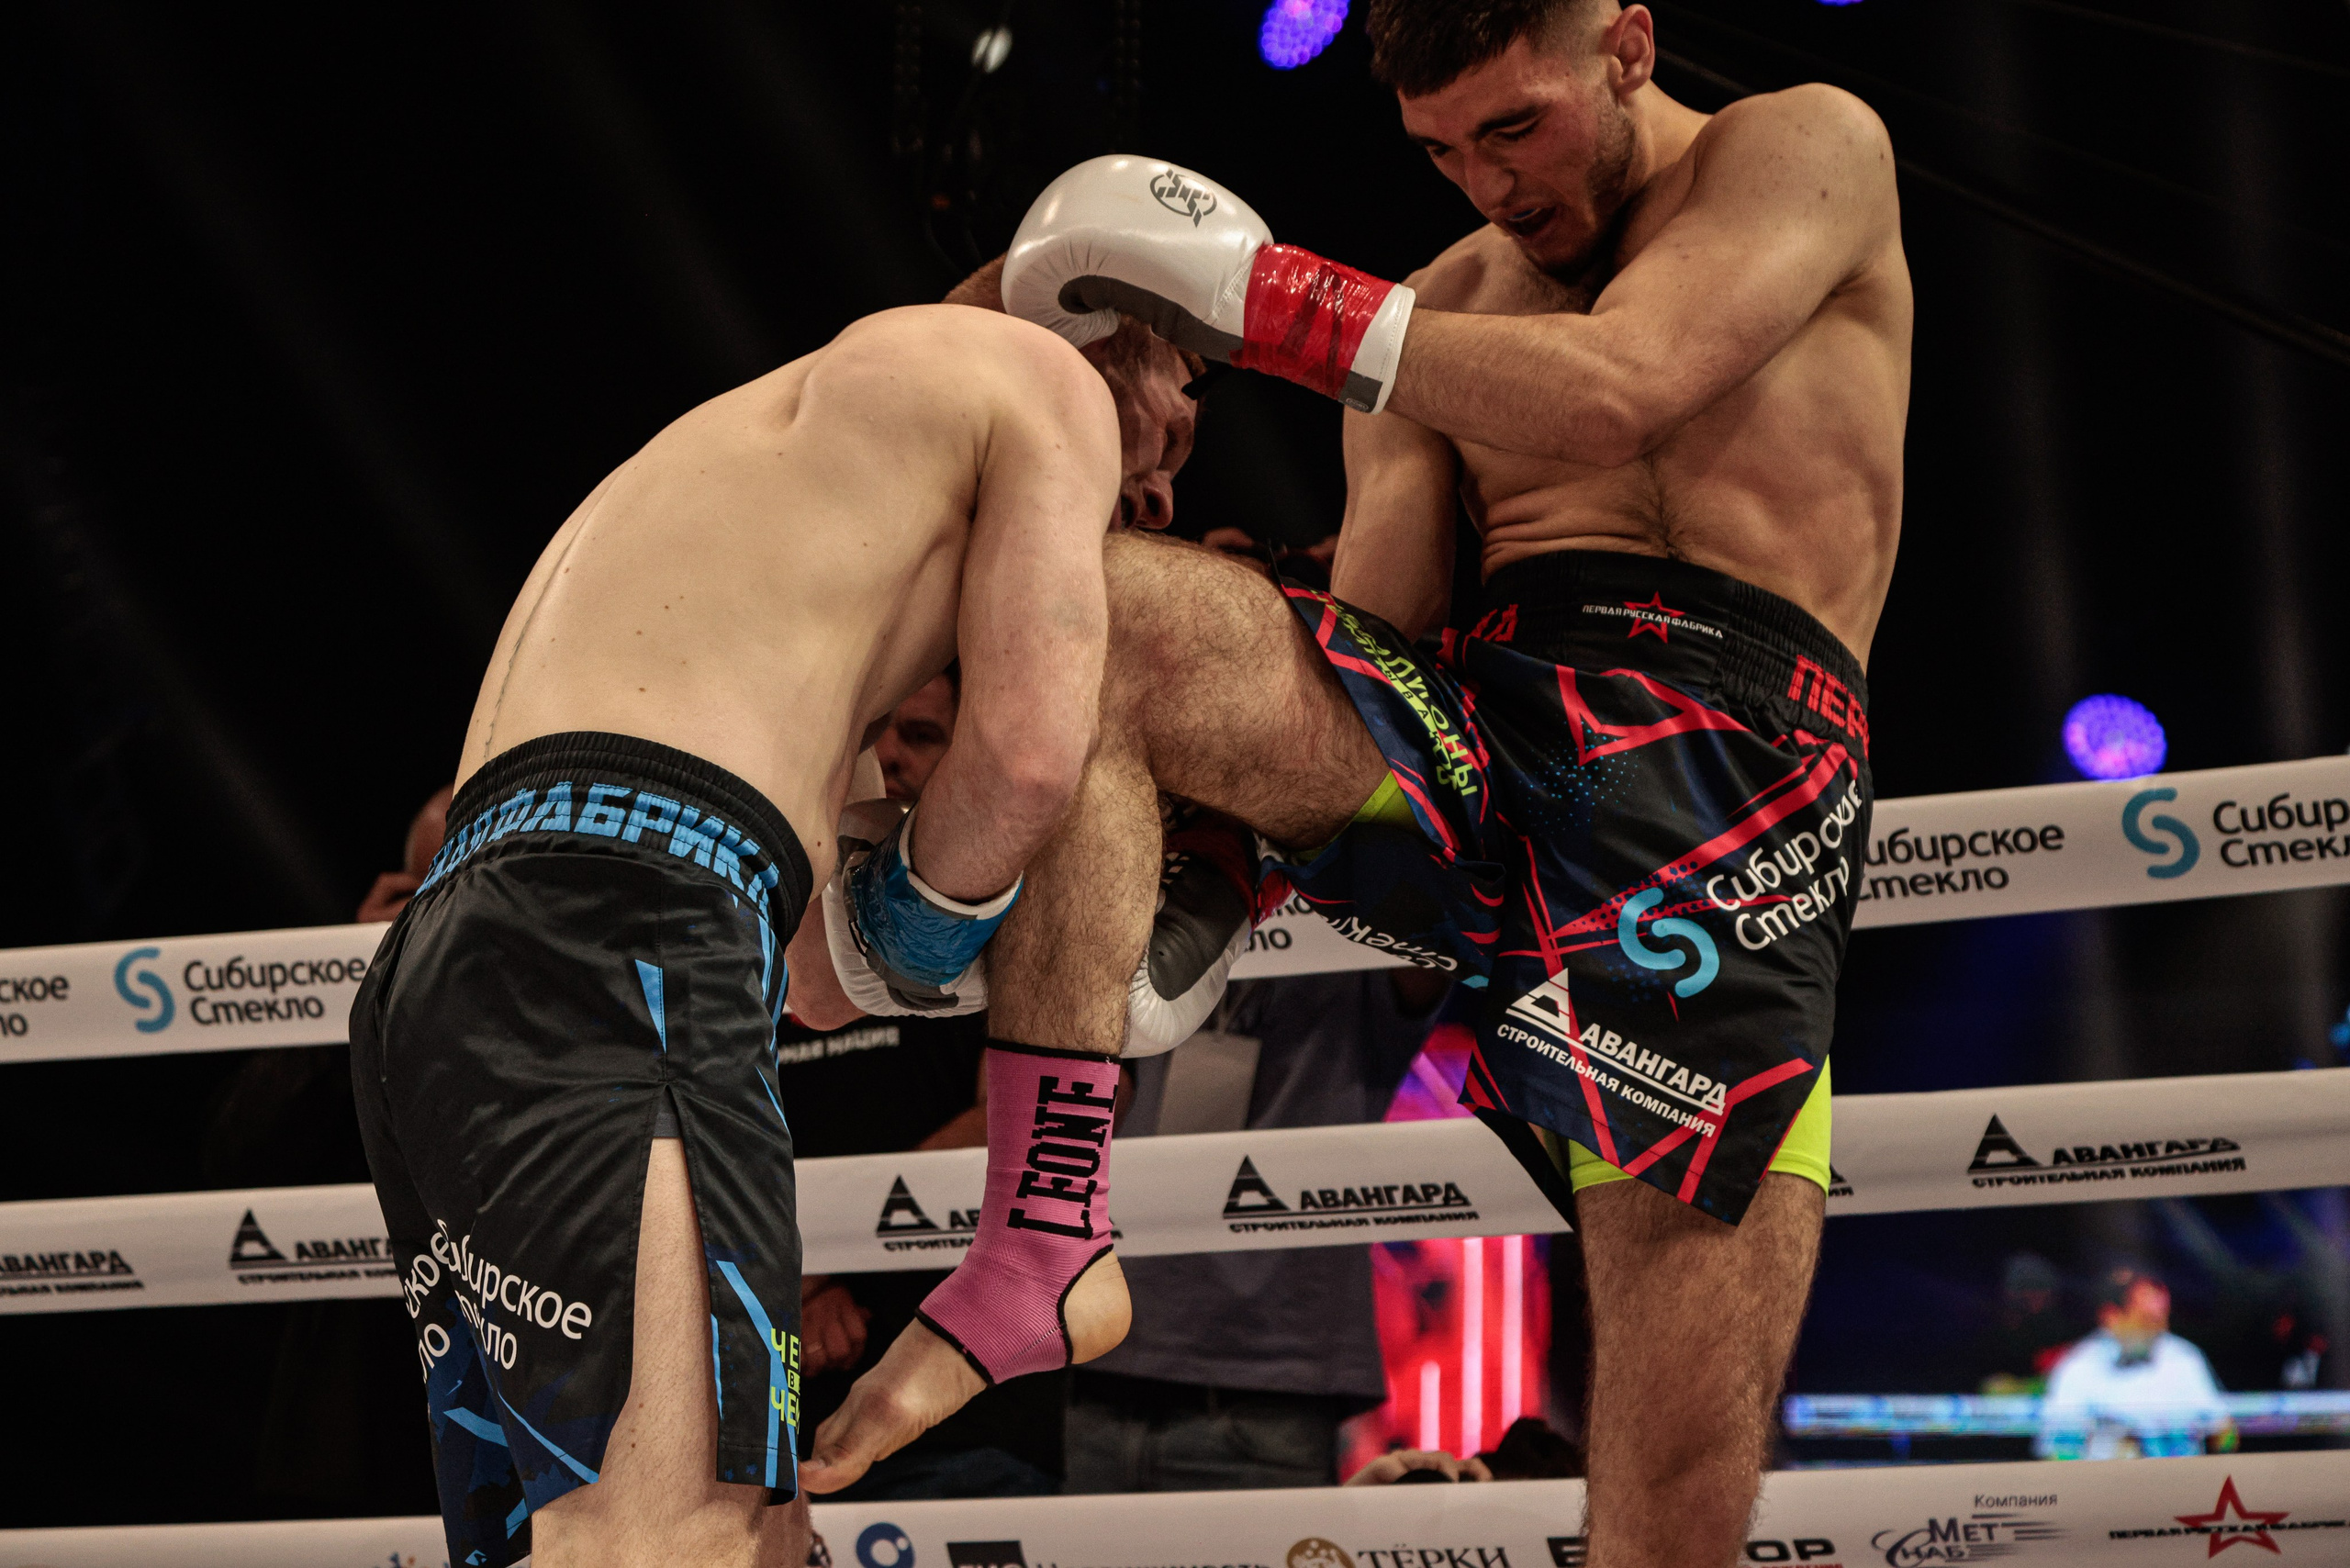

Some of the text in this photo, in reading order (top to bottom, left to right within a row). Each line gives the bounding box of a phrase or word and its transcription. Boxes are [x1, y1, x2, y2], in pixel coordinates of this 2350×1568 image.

[1582, 604, 1724, 640] ПЕРВАЯ РУССКАЯ ФАБРИКА
[1864, 823, 2065, 867] ибирское
[1858, 867, 2009, 902] текло
[185, 956, 367, 992] Сибирское
[190, 995, 326, 1025] Стекло
[1496, 1023, 1718, 1138] СТРОИТЕЛЬНАЯ КОМПАНИЯ
[1578, 1023, 1728, 1109] АВАНГАРД
[1007, 1075, 1119, 1240] LEONE
[1300, 1182, 1472, 1211] АВАНГАРД
[1974, 1493, 2058, 1508] Компания
[1357, 1543, 1518, 1568] ТЁРКИ
